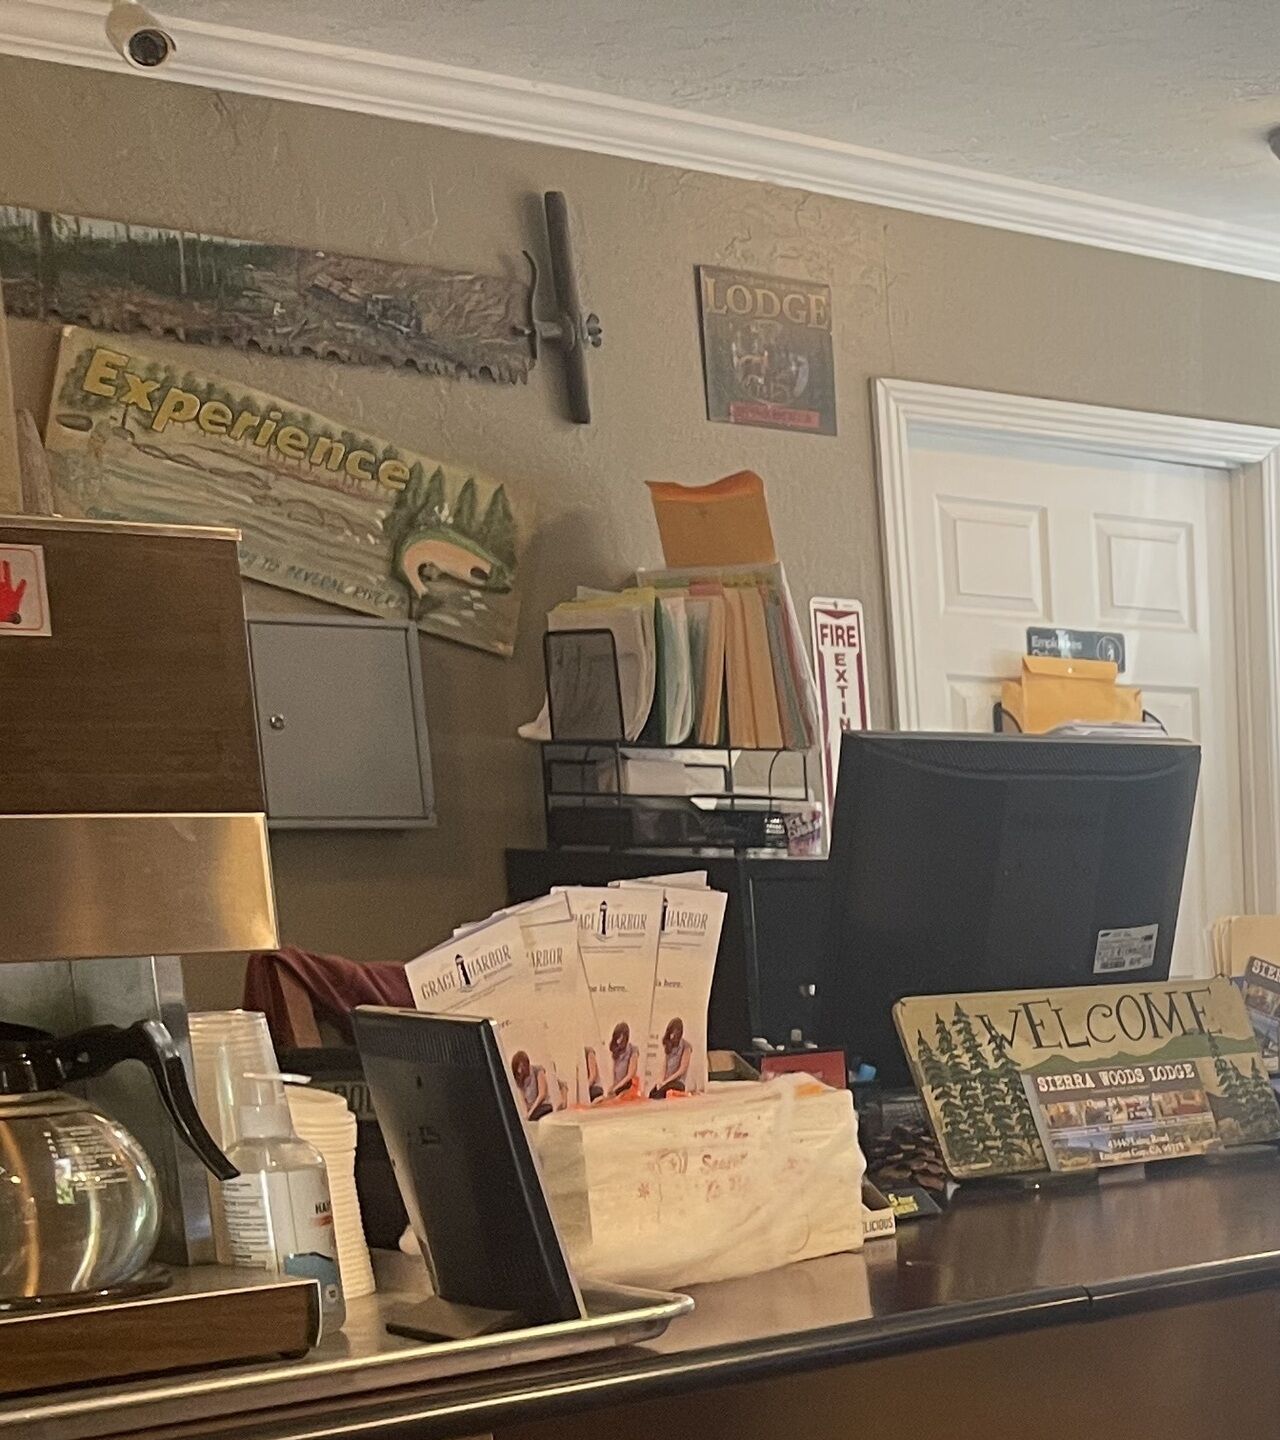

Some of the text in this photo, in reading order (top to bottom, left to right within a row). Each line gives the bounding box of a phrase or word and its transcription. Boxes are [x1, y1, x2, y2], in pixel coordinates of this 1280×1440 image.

[704, 276, 829, 331] LODGE
[83, 347, 411, 490] Experience
[820, 623, 857, 648] FIRE
[606, 913, 647, 931] HARBOR
[667, 911, 708, 930] HARBOR
[467, 943, 512, 980] HARBOR
[976, 987, 1223, 1053] WELCOME
[1037, 1062, 1196, 1093] SIERRA WOODS LODGE
